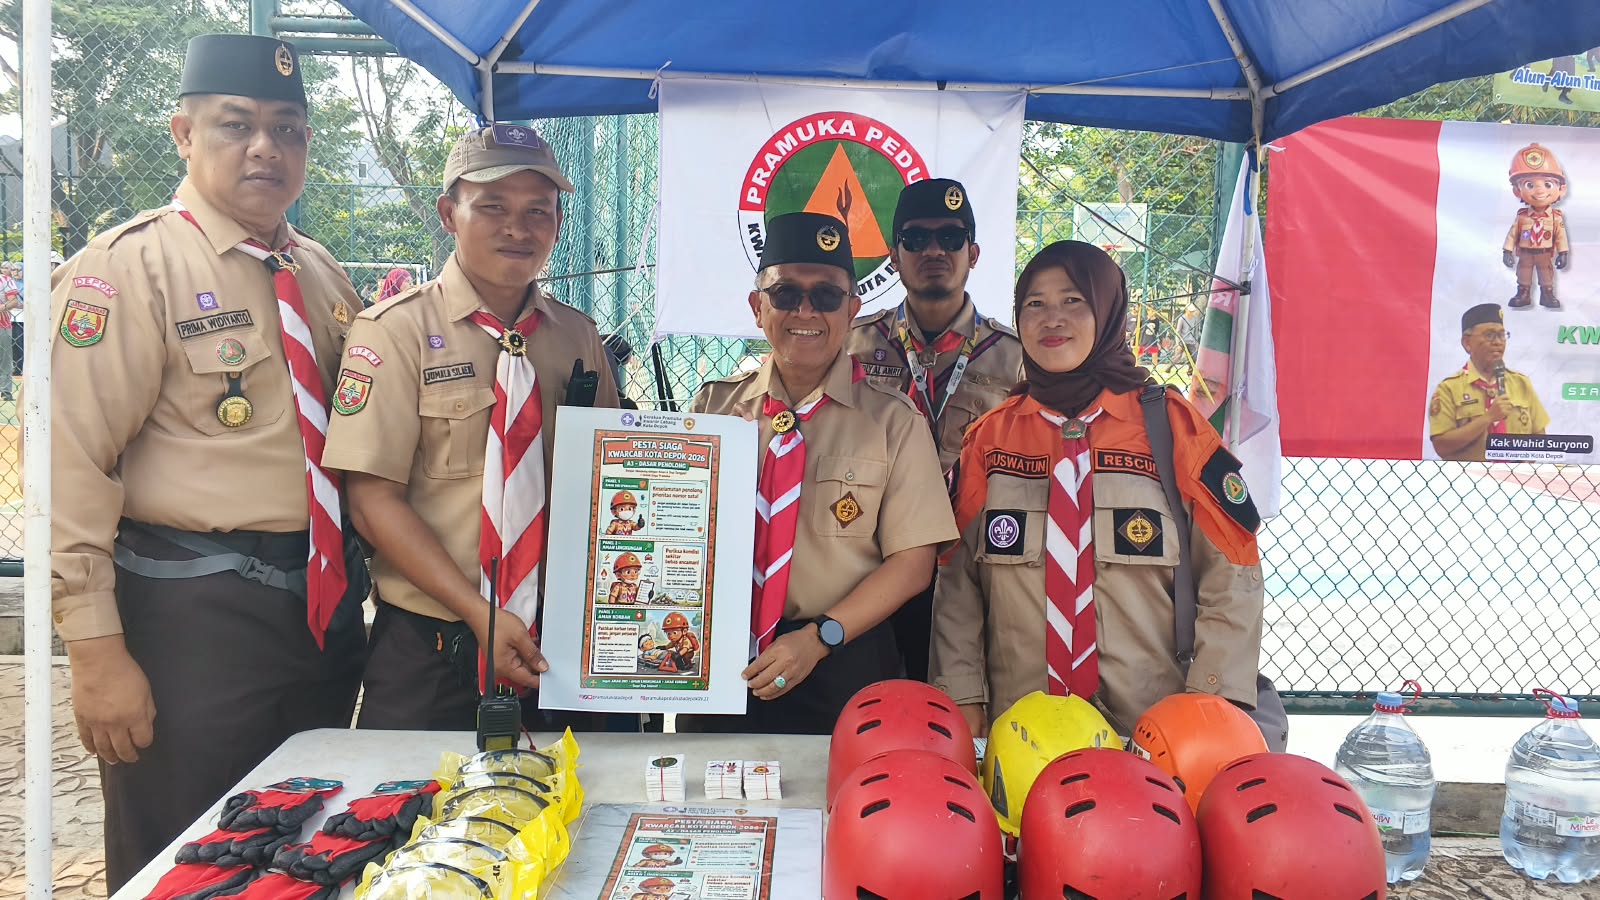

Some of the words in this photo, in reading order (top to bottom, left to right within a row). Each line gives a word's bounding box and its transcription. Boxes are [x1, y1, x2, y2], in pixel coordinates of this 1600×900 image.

[1513, 68, 1581, 88] Alun-Alun
[746, 118, 856, 205] PRAMUKA
[865, 126, 923, 184] PEDU
[76, 278, 116, 296] DEPOK
[857, 272, 887, 296] OTA
[180, 321, 207, 336] PRIMA
[207, 312, 249, 329] WIDIYANTO
[632, 440, 657, 450] PESTA
[659, 441, 683, 451] SIAGA
[1490, 438, 1510, 448] Kak
[1512, 438, 1545, 448] Wahid
[1547, 440, 1589, 451] Suryono
[608, 450, 643, 459] KWARCAB
[644, 451, 663, 460] KOTA
[664, 452, 687, 461] DEPOK
[688, 453, 706, 462] 2026
[1586, 816, 1595, 825] Le
